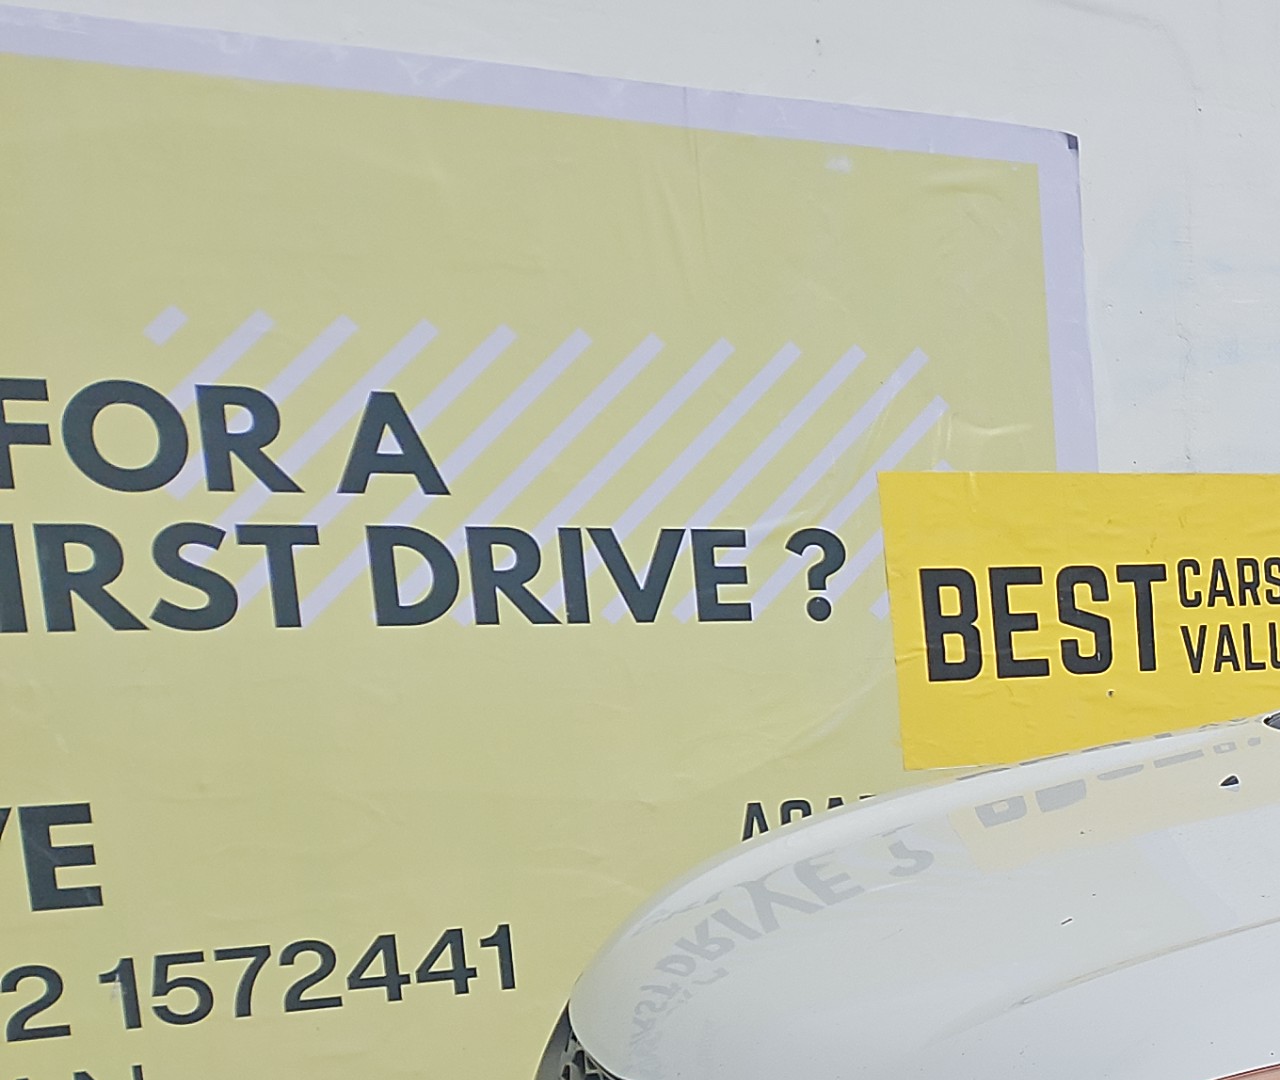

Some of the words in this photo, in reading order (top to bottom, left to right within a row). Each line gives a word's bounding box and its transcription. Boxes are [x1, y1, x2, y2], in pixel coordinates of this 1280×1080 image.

[0, 378, 305, 492] FOR
[337, 391, 450, 495] A
[0, 522, 319, 633] IRST
[365, 525, 752, 626] DRIVE
[785, 527, 847, 622] ?
[919, 564, 1168, 682] BEST
[98, 923, 516, 1030] 1572441
